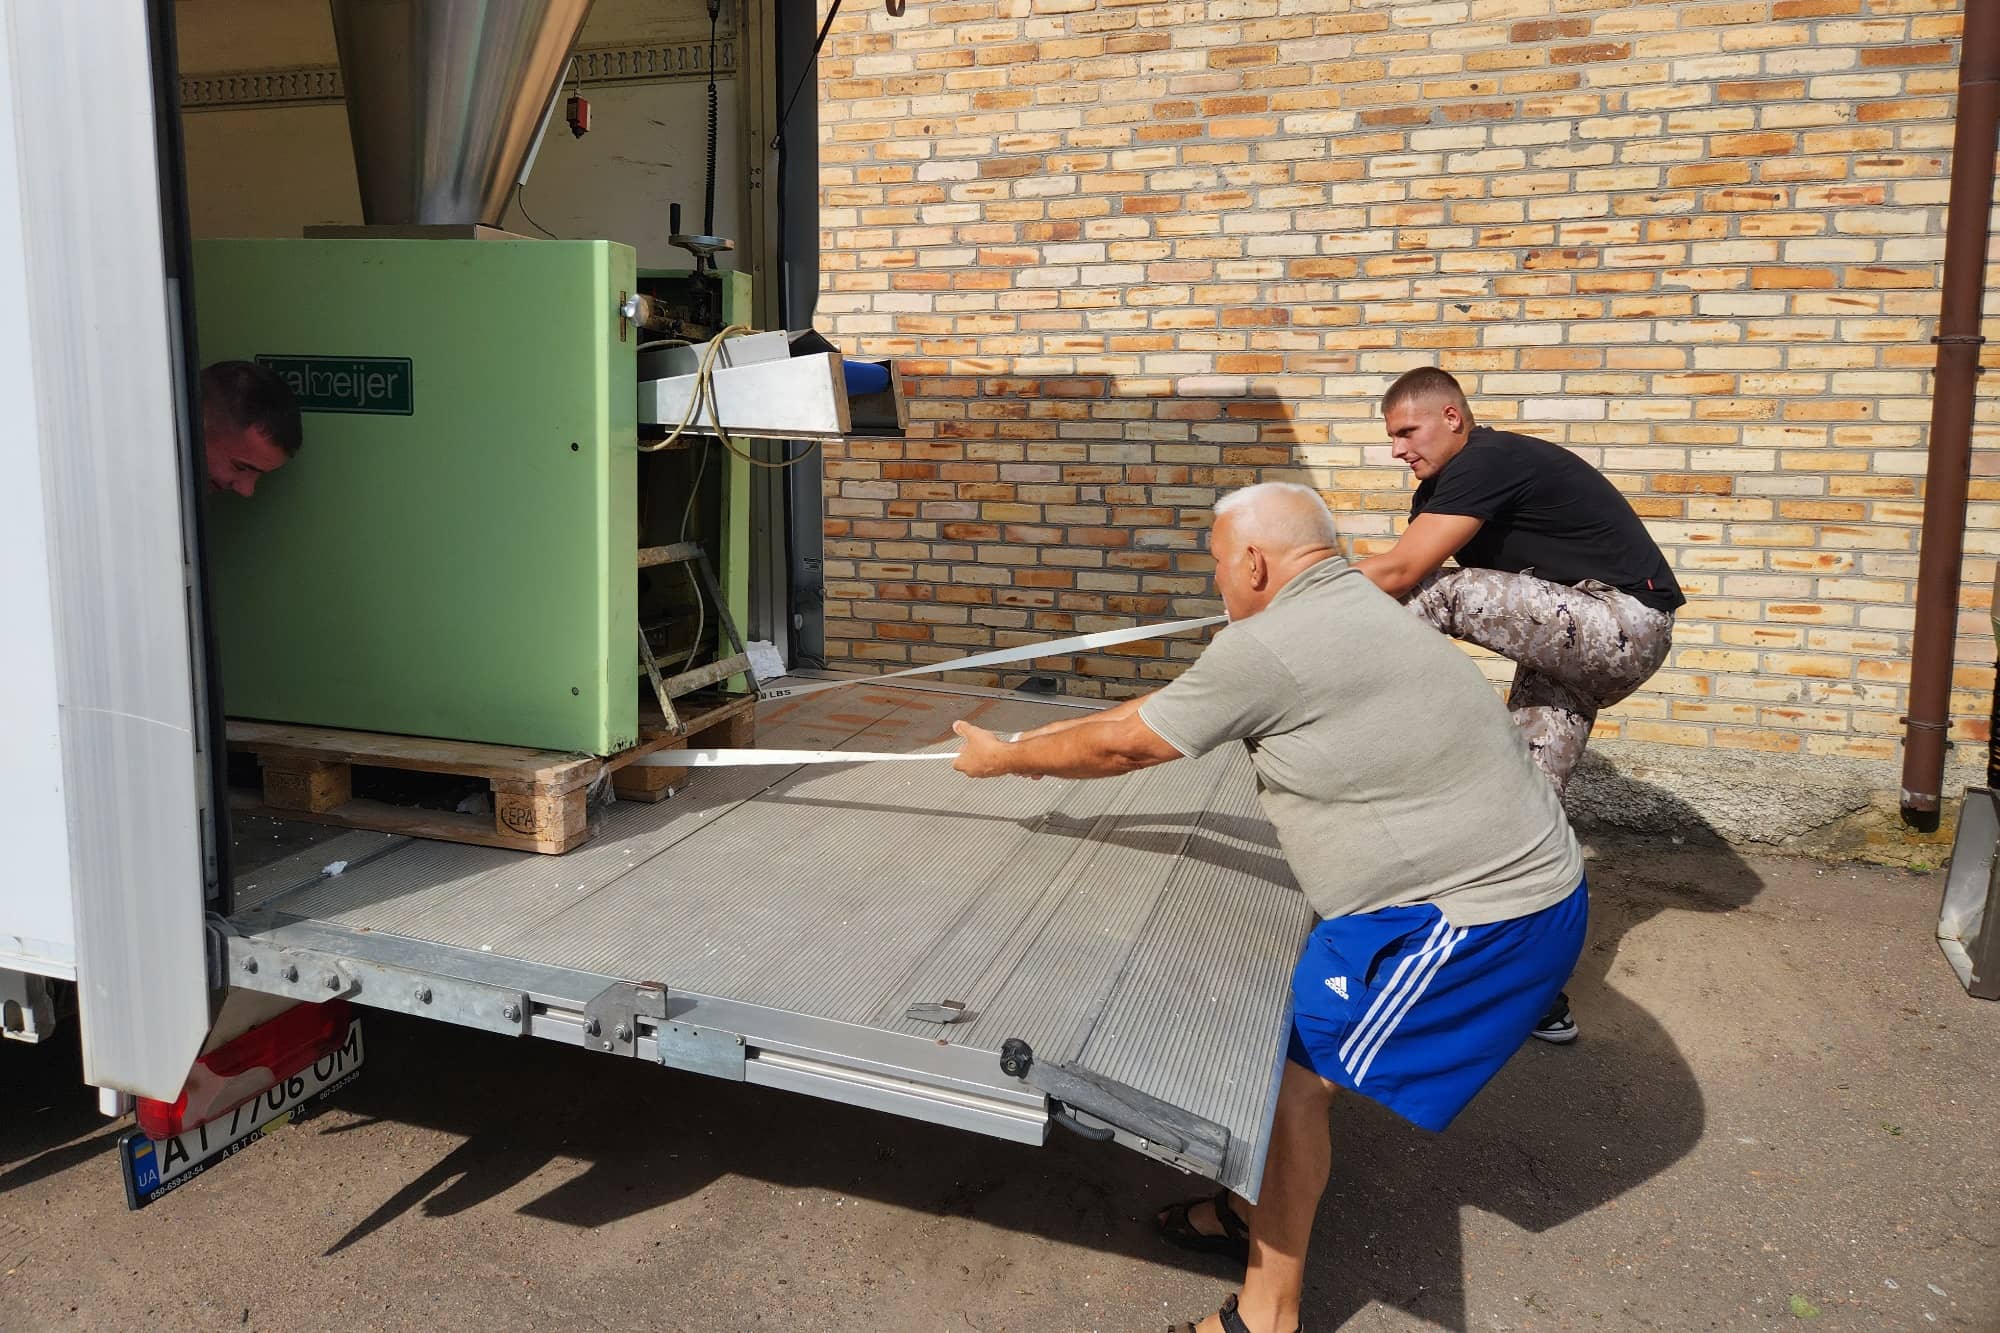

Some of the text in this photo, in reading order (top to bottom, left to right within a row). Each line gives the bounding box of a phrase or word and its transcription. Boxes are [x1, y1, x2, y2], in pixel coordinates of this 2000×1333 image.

[278, 363, 399, 407] almeijer
[769, 688, 792, 699] LBS
[138, 1168, 158, 1187] UA
